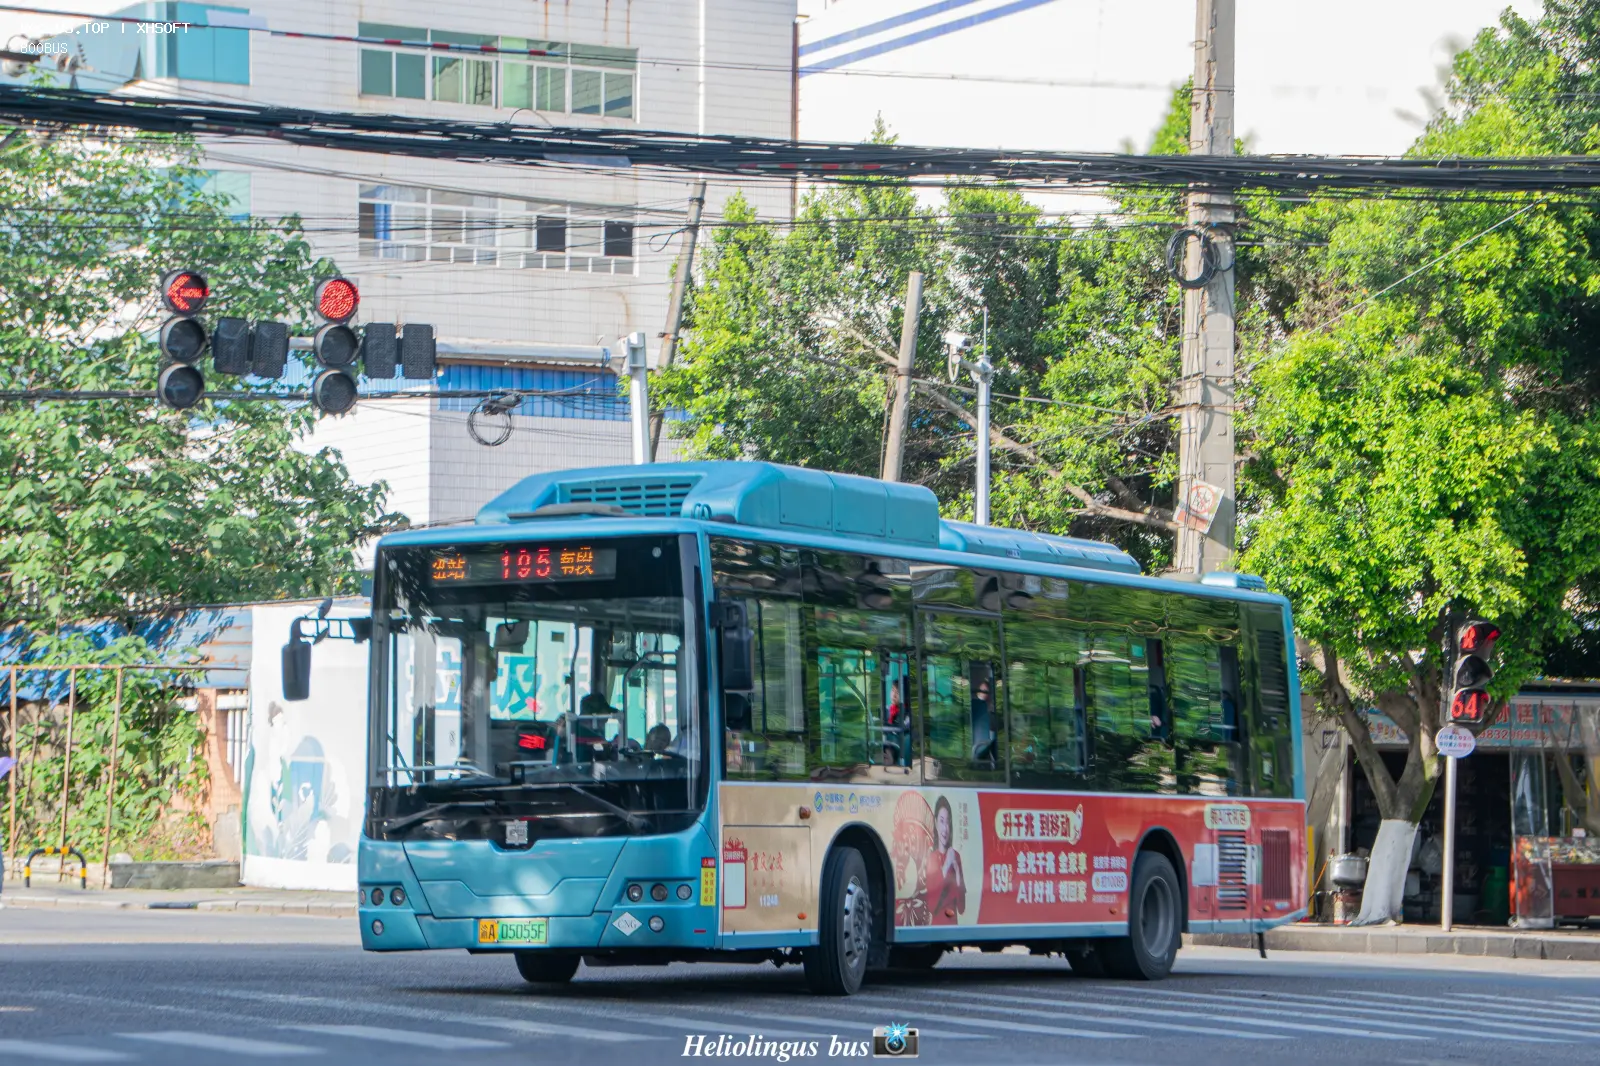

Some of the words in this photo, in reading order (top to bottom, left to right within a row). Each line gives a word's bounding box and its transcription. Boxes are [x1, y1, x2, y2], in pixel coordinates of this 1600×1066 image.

[1451, 690, 1478, 719] 64
[1002, 812, 1035, 838] 升千兆
[1039, 812, 1071, 839] 到移动
[990, 863, 1009, 893] 139
[617, 919, 637, 929] CNG
